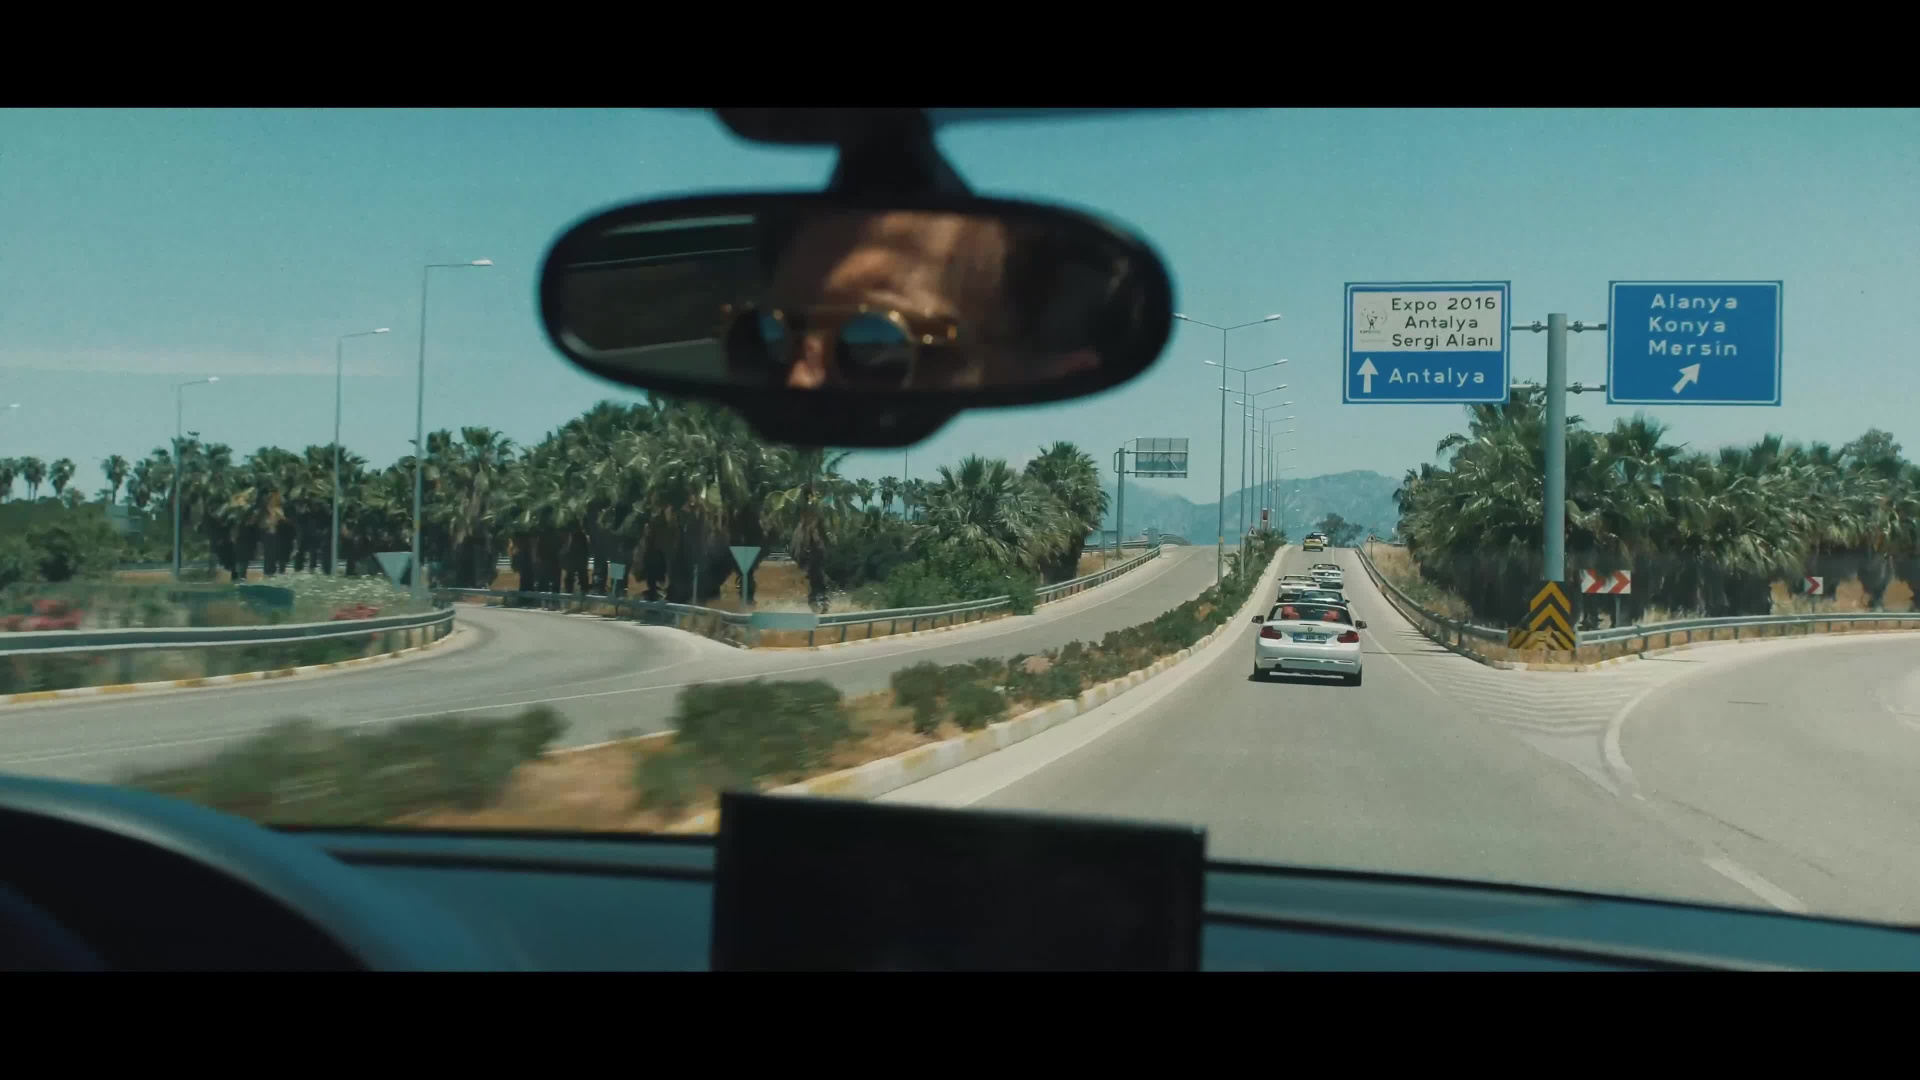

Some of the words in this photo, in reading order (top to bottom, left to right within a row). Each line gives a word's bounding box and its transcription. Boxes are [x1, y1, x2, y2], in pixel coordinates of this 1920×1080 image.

[1391, 297, 1437, 314] Expo
[1447, 297, 1496, 310] 2016
[1650, 293, 1738, 313] Alanya
[1404, 315, 1478, 332] Antalya
[1648, 316, 1726, 336] Konya
[1392, 333, 1439, 350] Sergi
[1446, 333, 1493, 347] Alanı
[1648, 339, 1738, 356] Mersin
[1388, 367, 1485, 388] Antalya
